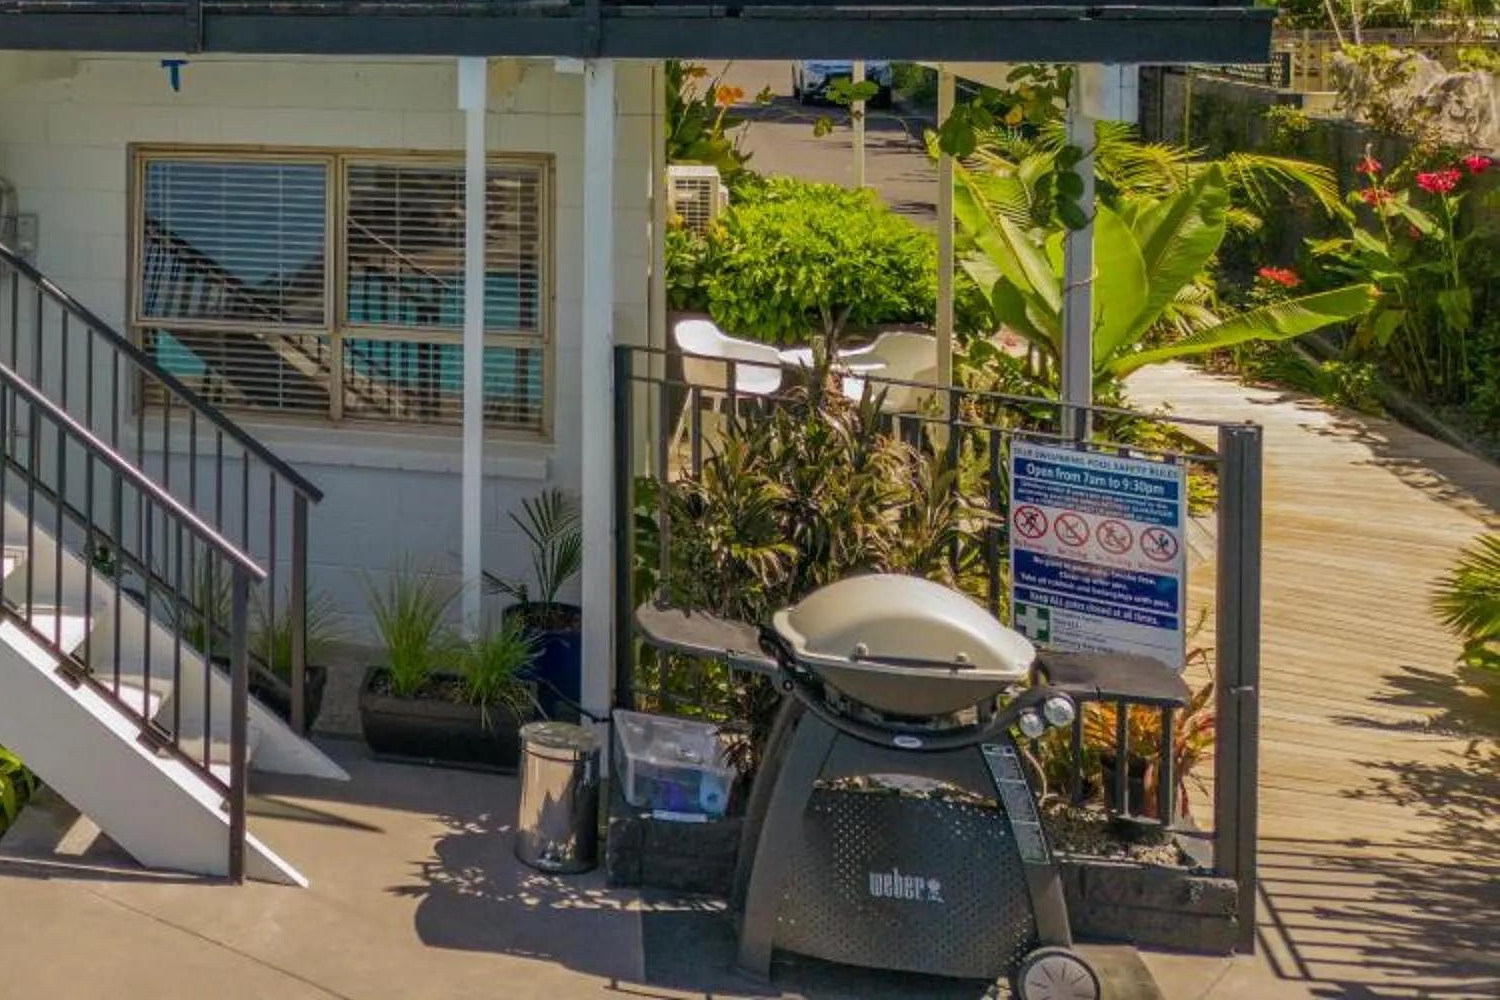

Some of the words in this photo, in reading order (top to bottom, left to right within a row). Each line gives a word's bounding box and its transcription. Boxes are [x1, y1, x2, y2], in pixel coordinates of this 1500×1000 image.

[1027, 463, 1054, 479] Open
[1055, 467, 1081, 482] from
[1083, 471, 1105, 486] 7am
[1107, 475, 1120, 488] to
[1122, 479, 1164, 495] 9:30pm
[869, 867, 925, 900] weber
